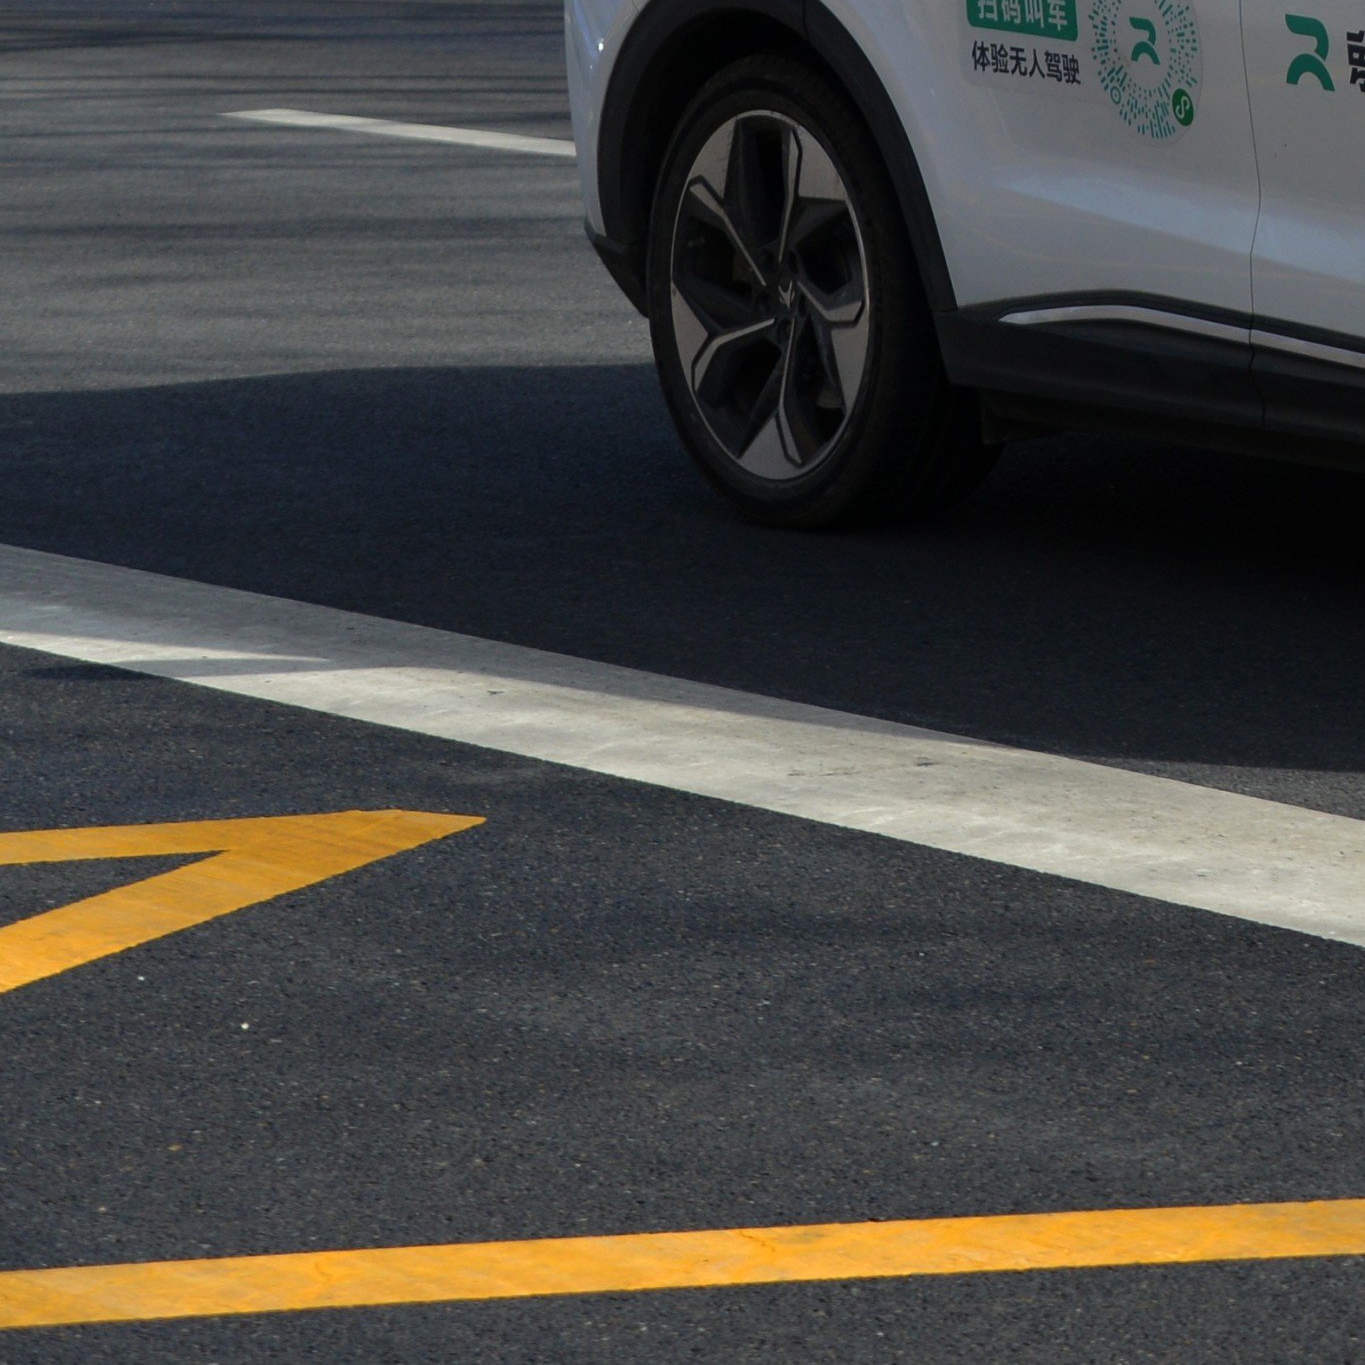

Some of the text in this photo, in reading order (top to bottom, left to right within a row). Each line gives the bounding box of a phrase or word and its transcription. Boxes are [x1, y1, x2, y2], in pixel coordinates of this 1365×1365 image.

[972, 40, 1081, 85] 体验无人驾驶
